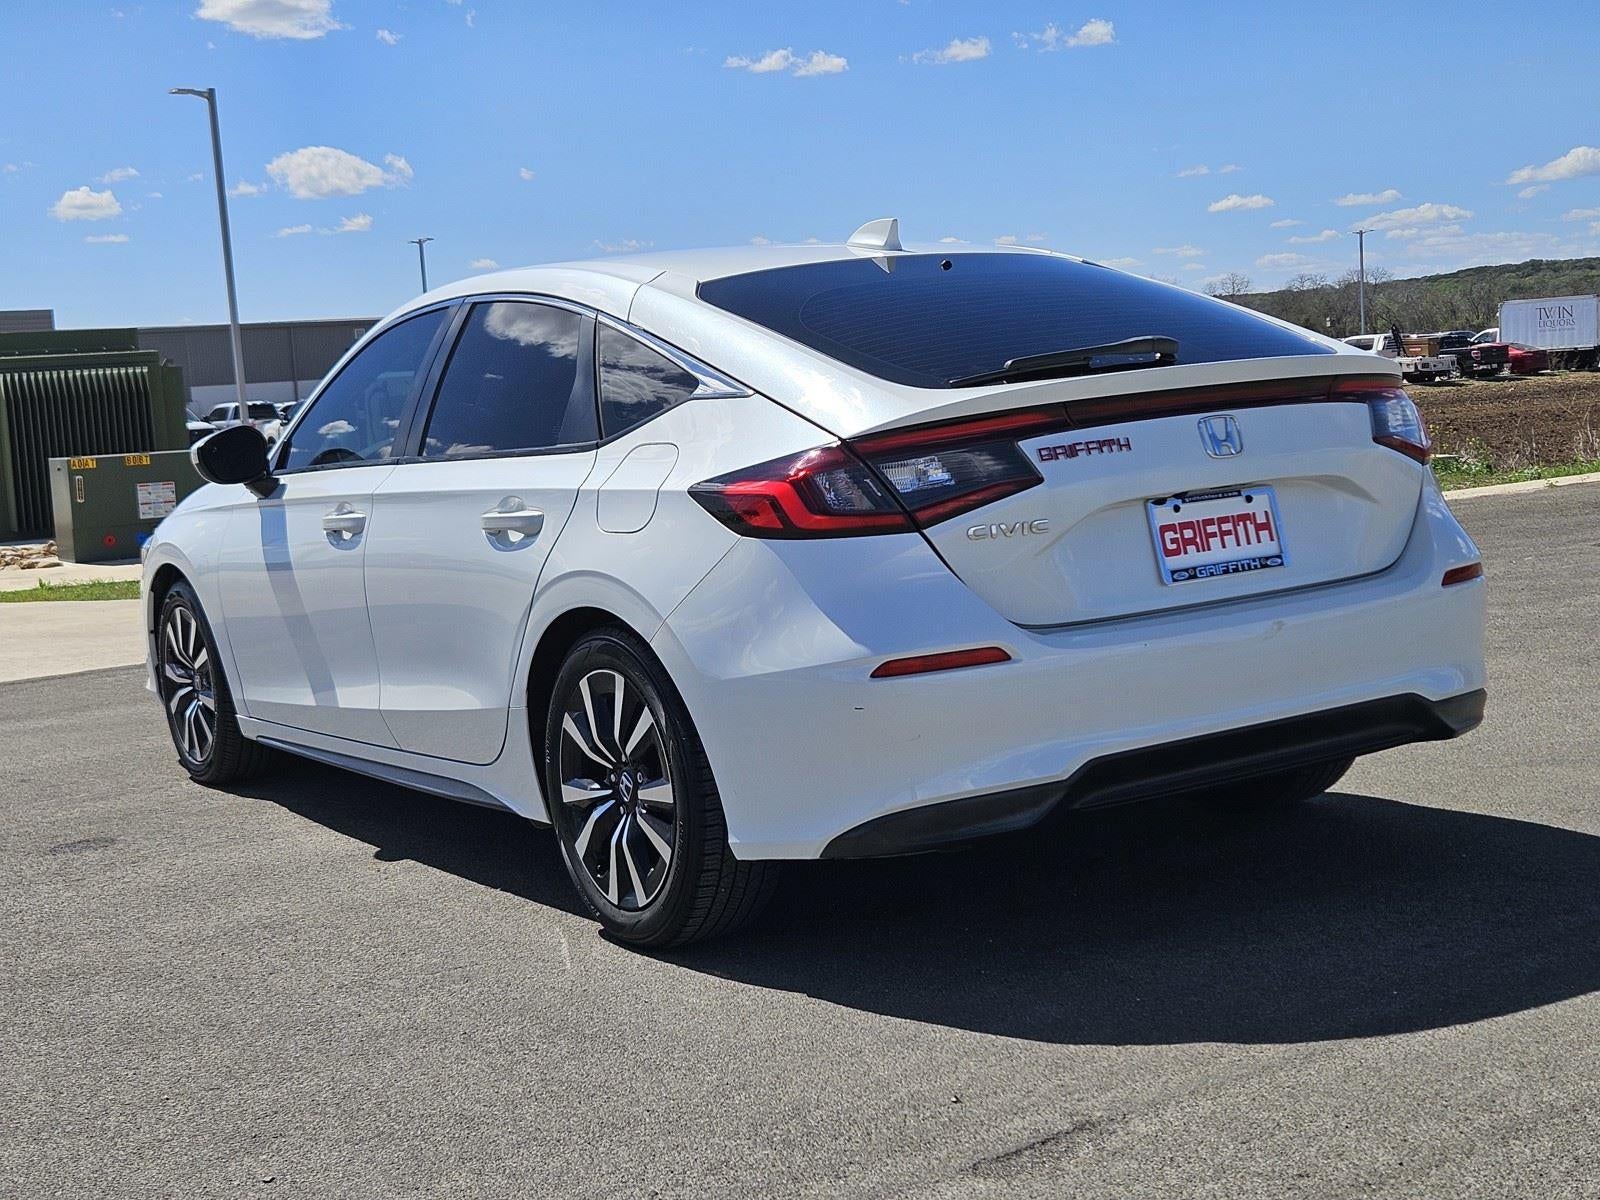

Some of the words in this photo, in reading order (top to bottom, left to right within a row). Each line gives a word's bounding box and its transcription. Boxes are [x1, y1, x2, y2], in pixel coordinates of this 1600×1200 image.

[1536, 305, 1573, 320] TWIN
[1538, 318, 1576, 328] LIQUORS
[967, 518, 1048, 541] CIVIC
[1159, 510, 1275, 557] GRIFFITH
[1195, 558, 1261, 578] GRIFFITH
